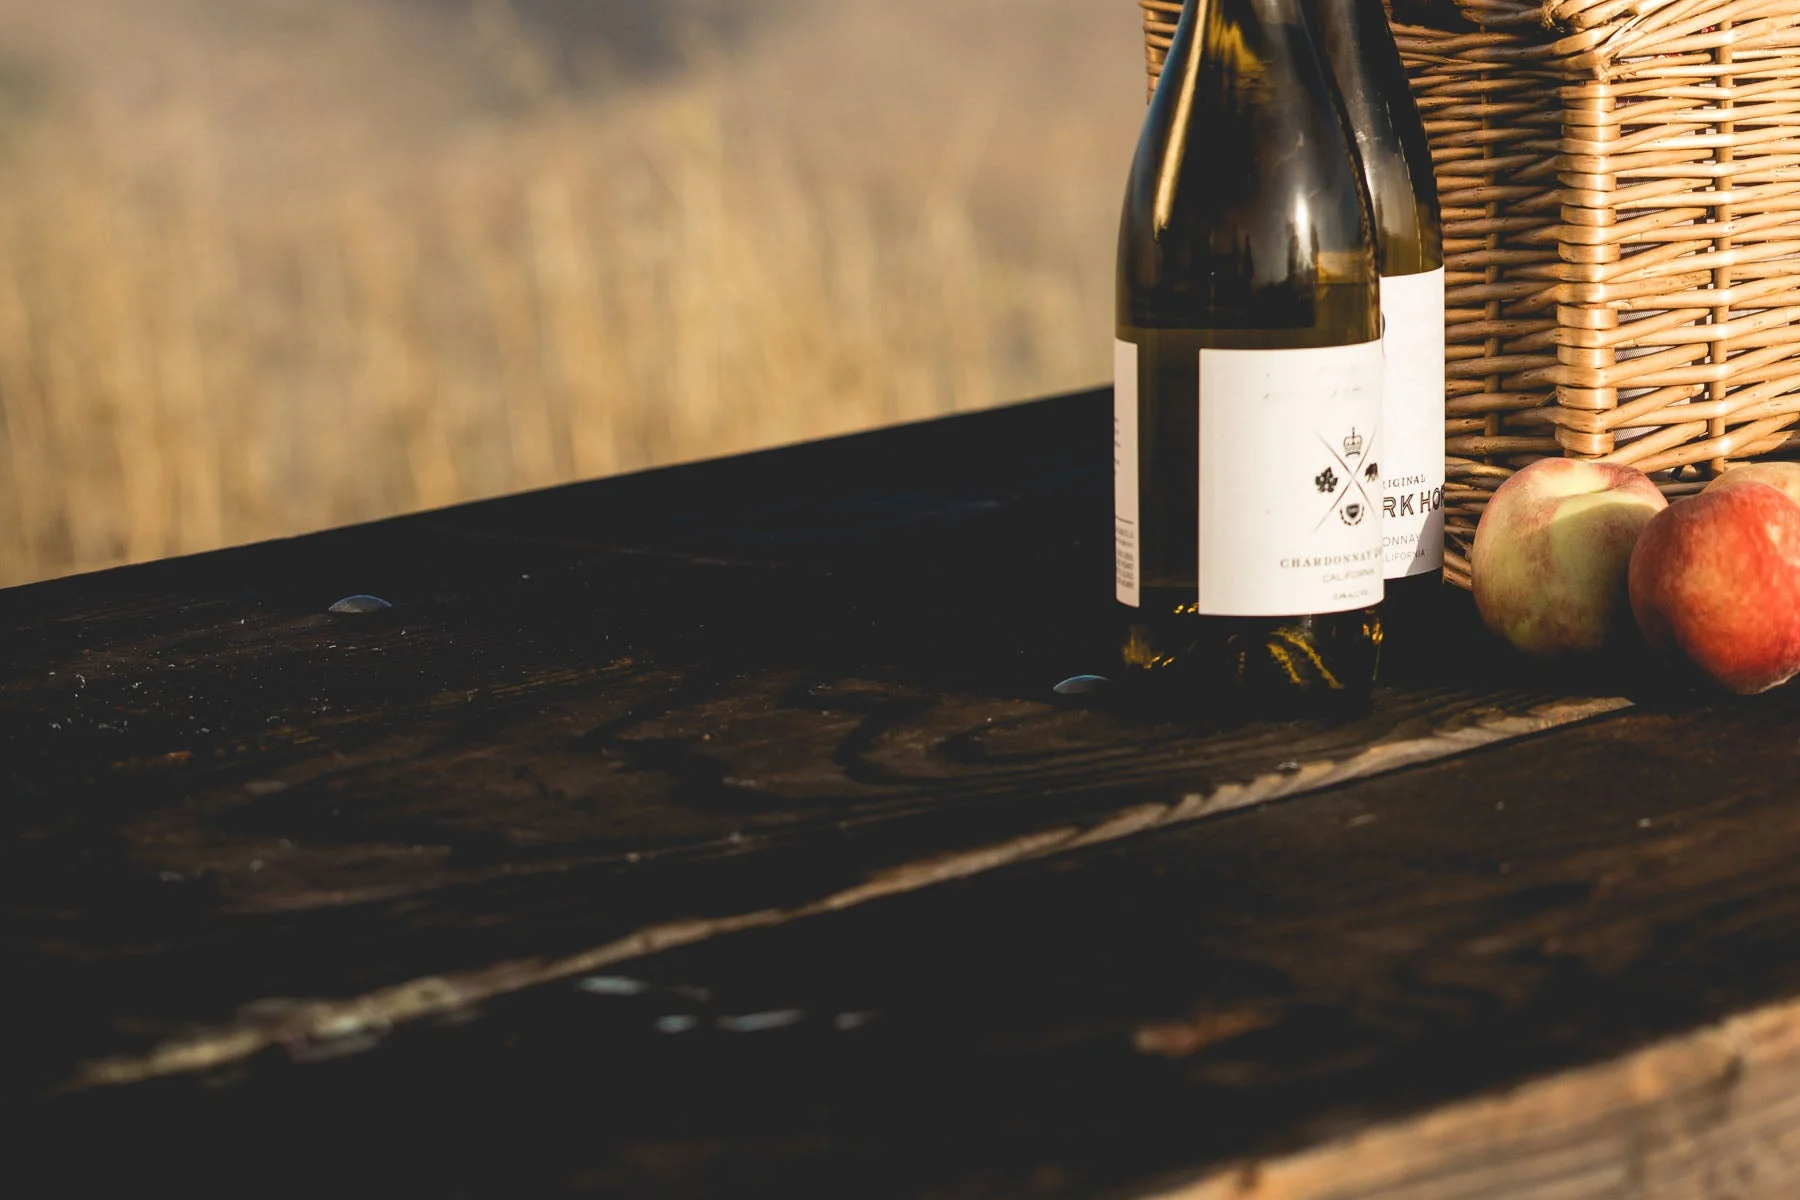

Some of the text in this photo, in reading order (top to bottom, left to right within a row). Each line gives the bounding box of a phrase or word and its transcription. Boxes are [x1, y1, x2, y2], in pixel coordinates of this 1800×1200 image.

[1382, 492, 1414, 518] RK
[1382, 532, 1421, 547] ONNAY
[1383, 548, 1426, 562] LIFORNIA
